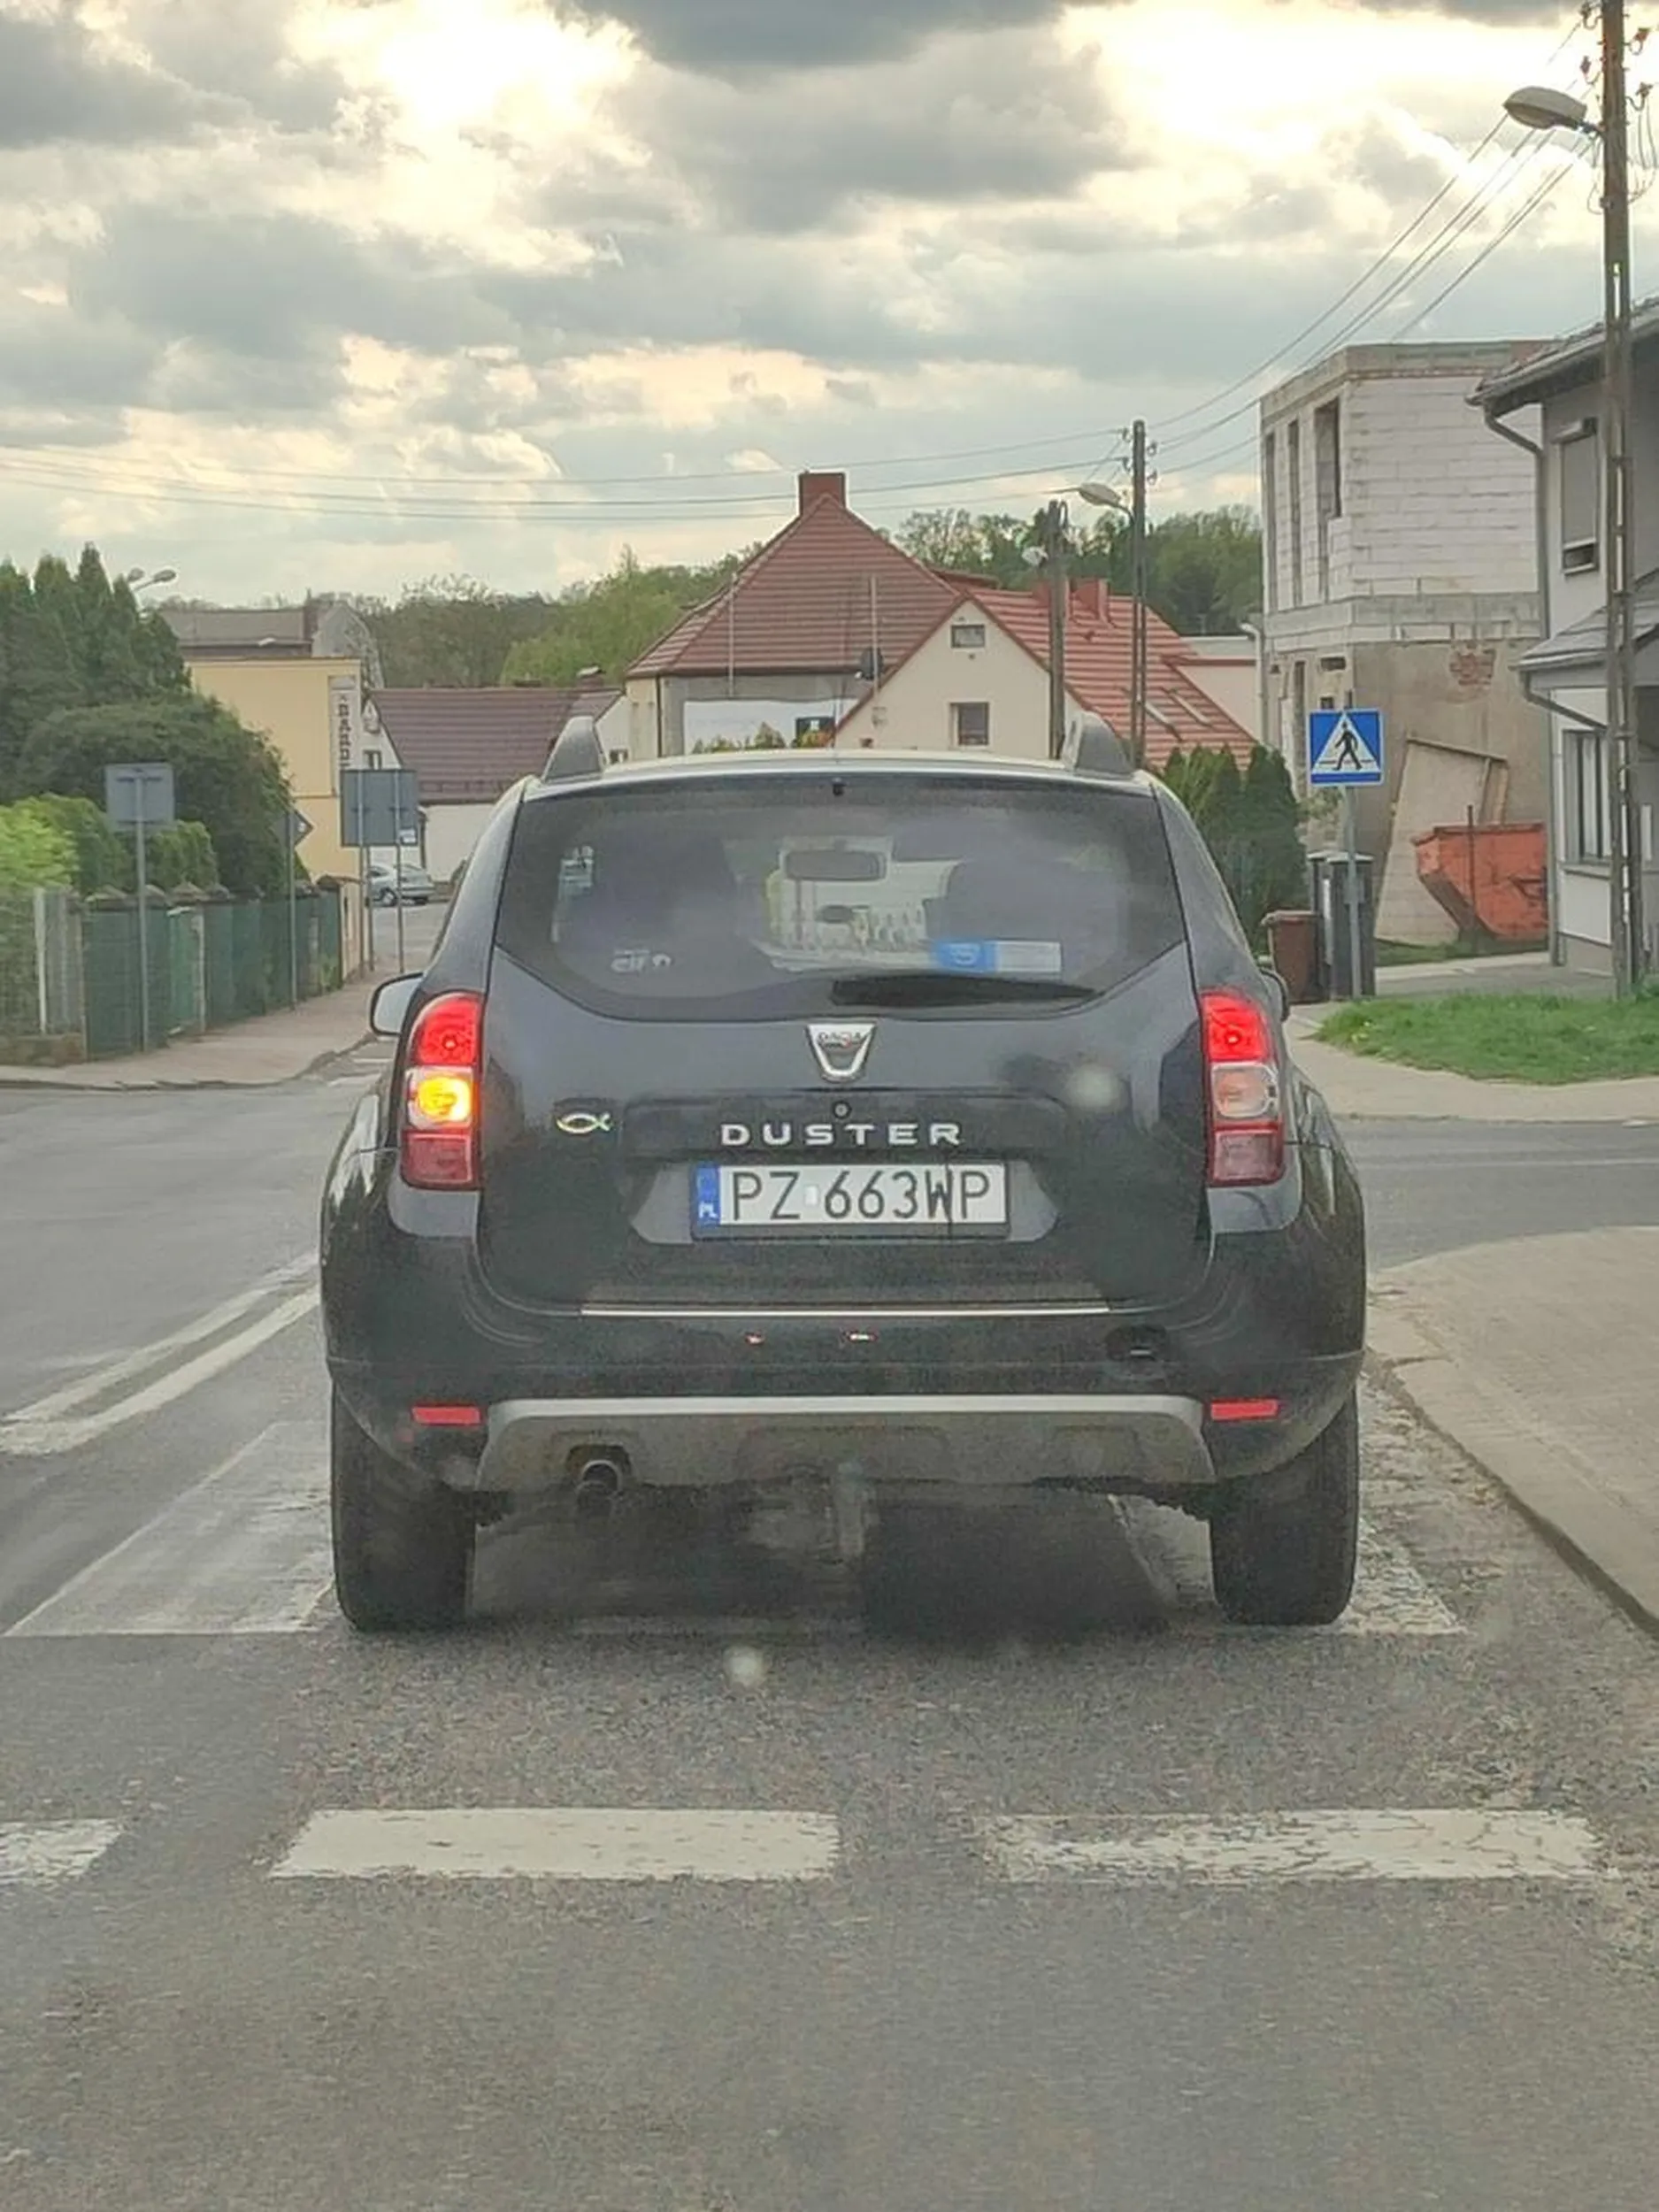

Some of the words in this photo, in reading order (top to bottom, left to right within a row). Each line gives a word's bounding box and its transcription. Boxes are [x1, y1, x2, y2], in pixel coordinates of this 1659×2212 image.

[719, 1123, 961, 1145] DUSTER
[732, 1171, 801, 1220] PZ
[824, 1170, 990, 1219] 663WP
